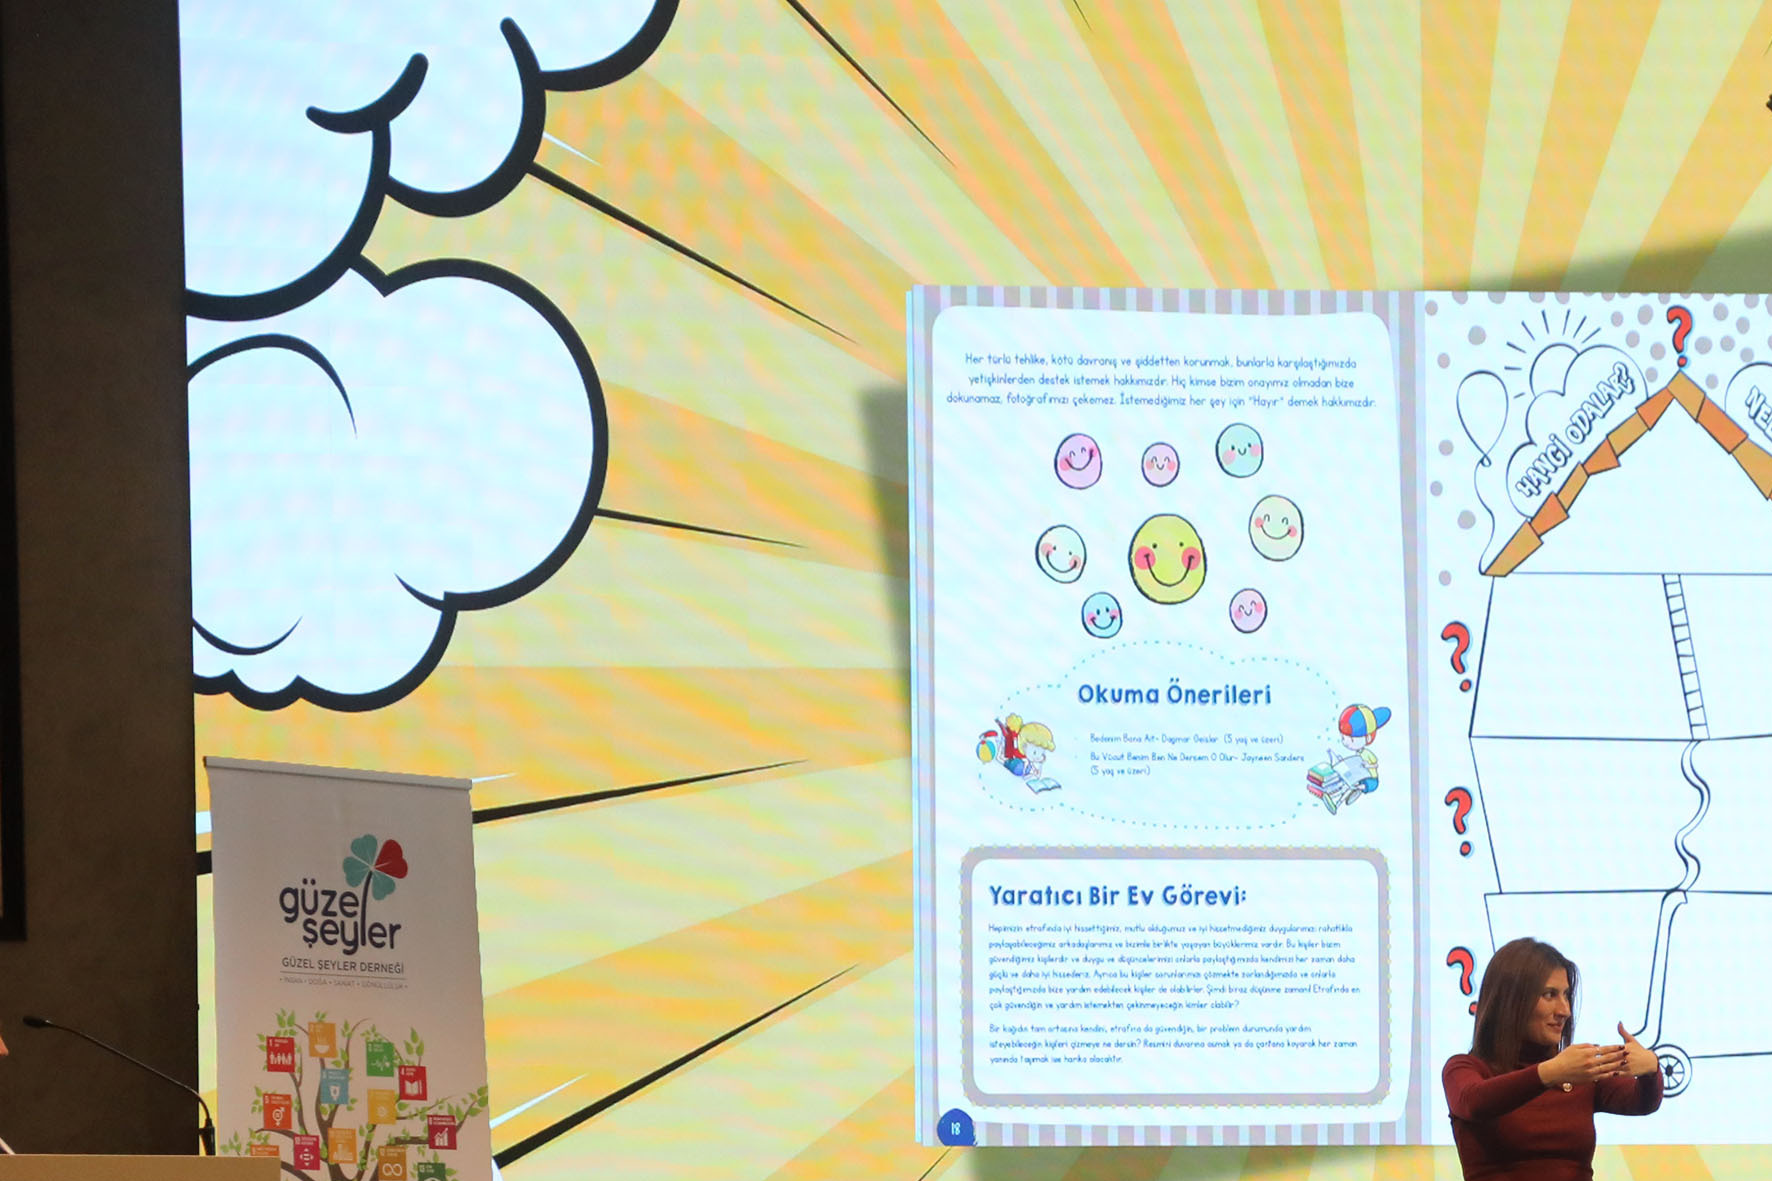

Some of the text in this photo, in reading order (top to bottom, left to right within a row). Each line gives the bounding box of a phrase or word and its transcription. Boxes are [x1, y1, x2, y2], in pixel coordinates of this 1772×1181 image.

[965, 353, 984, 364] Her
[1235, 356, 1275, 367] bunlarla
[1038, 373, 1070, 385] destek
[1292, 376, 1333, 388] olmadan
[1334, 377, 1355, 388] bize
[1189, 394, 1206, 406] her
[1287, 396, 1319, 407] demek
[1515, 361, 1637, 498] HANGİ ODALAR?
[1078, 678, 1271, 705] Okuma Önerileri
[280, 872, 371, 923] güzel
[989, 884, 1247, 906] Yaratıcı Bir Ev Görevi:
[303, 917, 401, 955] şeyler
[282, 956, 405, 974] GÜZEL ŞEYLER DERNEĞİ
[951, 1121, 961, 1136] 18
